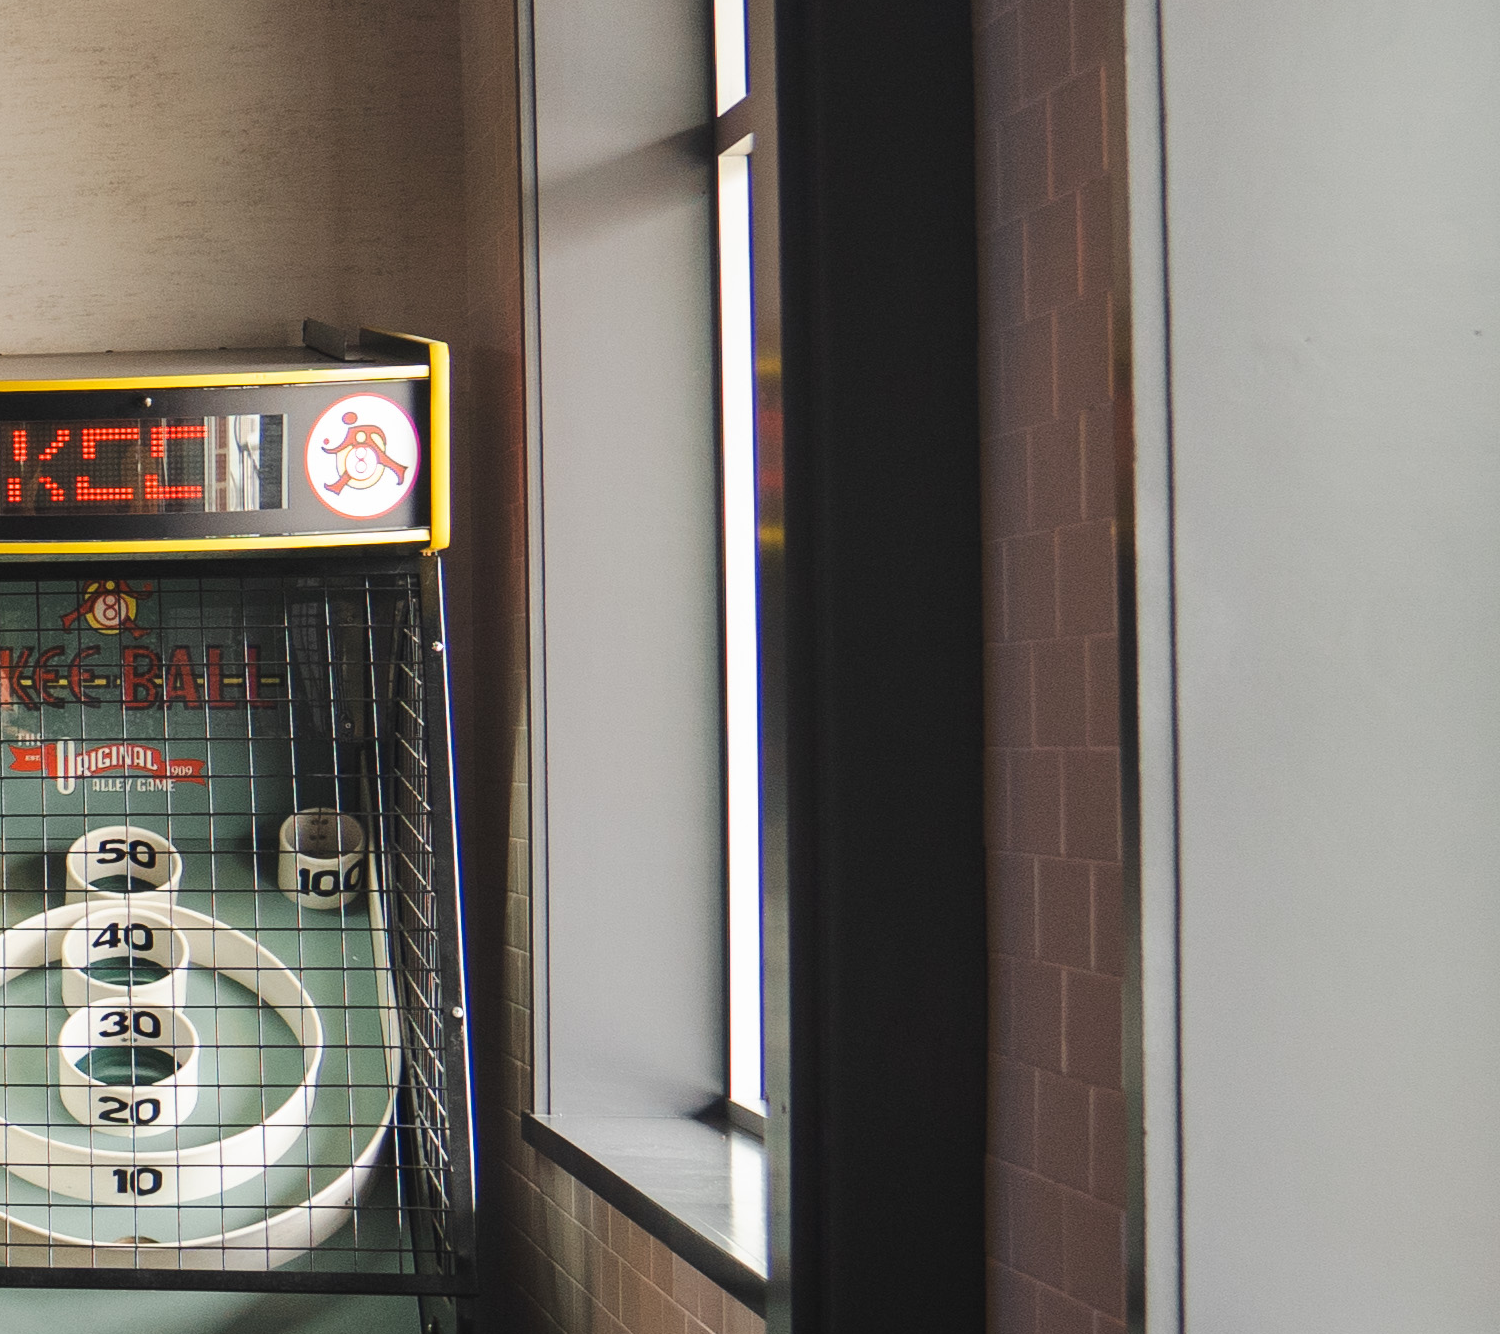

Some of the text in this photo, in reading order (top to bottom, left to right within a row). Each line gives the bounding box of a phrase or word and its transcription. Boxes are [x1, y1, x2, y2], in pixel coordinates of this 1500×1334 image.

[120, 643, 278, 711] BALL
[92, 778, 176, 792] ALLEY GAME
[96, 838, 157, 869] 50
[298, 858, 362, 898] 100
[91, 922, 155, 952] 40
[98, 1010, 162, 1039] 30
[98, 1096, 162, 1125] 20
[112, 1167, 163, 1196] 10
